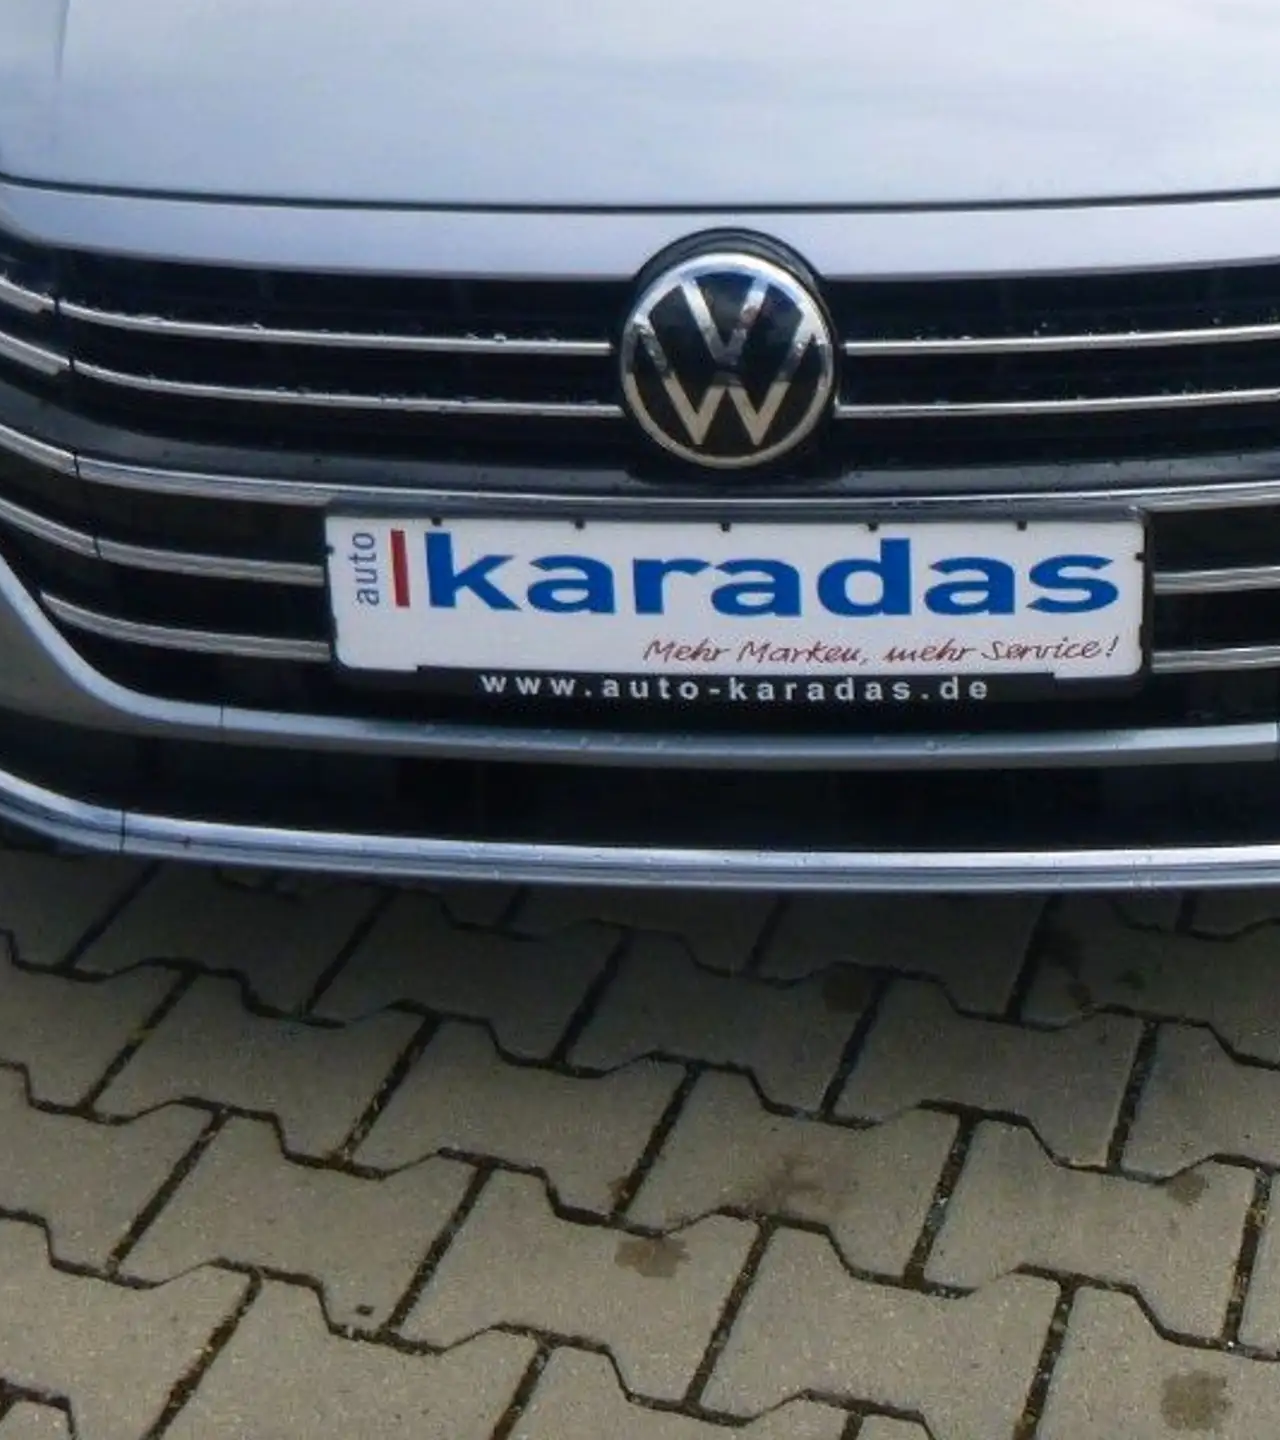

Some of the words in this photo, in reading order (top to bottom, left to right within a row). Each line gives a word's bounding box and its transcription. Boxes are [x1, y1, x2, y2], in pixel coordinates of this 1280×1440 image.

[348, 531, 381, 607] auto
[424, 531, 1120, 618] karadas
[642, 638, 732, 664] Mehr
[882, 637, 978, 664] mehr
[980, 635, 1121, 662] Service!
[480, 674, 989, 702] www.auto-karadas.de
